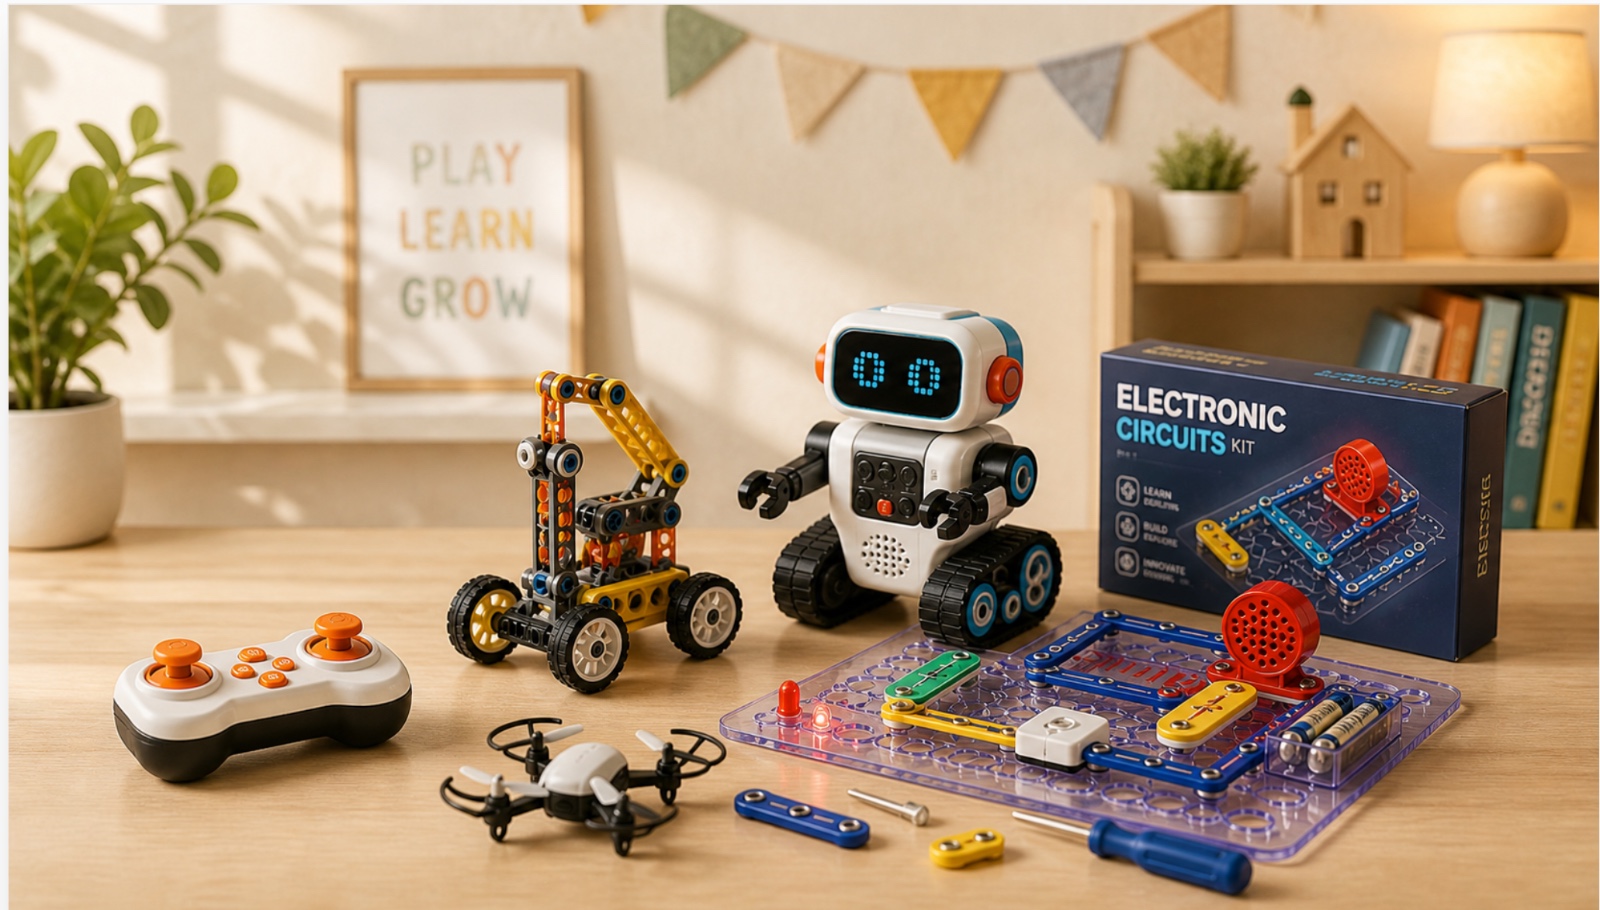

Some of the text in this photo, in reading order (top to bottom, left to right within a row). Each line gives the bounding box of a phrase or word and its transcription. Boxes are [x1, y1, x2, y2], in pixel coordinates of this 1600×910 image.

[411, 143, 522, 186] PLAY
[400, 208, 534, 251] LEARN
[400, 276, 533, 321] GROW
[1116, 382, 1287, 433] ELECTRONIC
[1115, 416, 1255, 456] CIRCUITS KIT
[1143, 486, 1172, 500] LEARN
[1143, 521, 1168, 535] BUILD
[1143, 558, 1186, 576] INNOVATE
